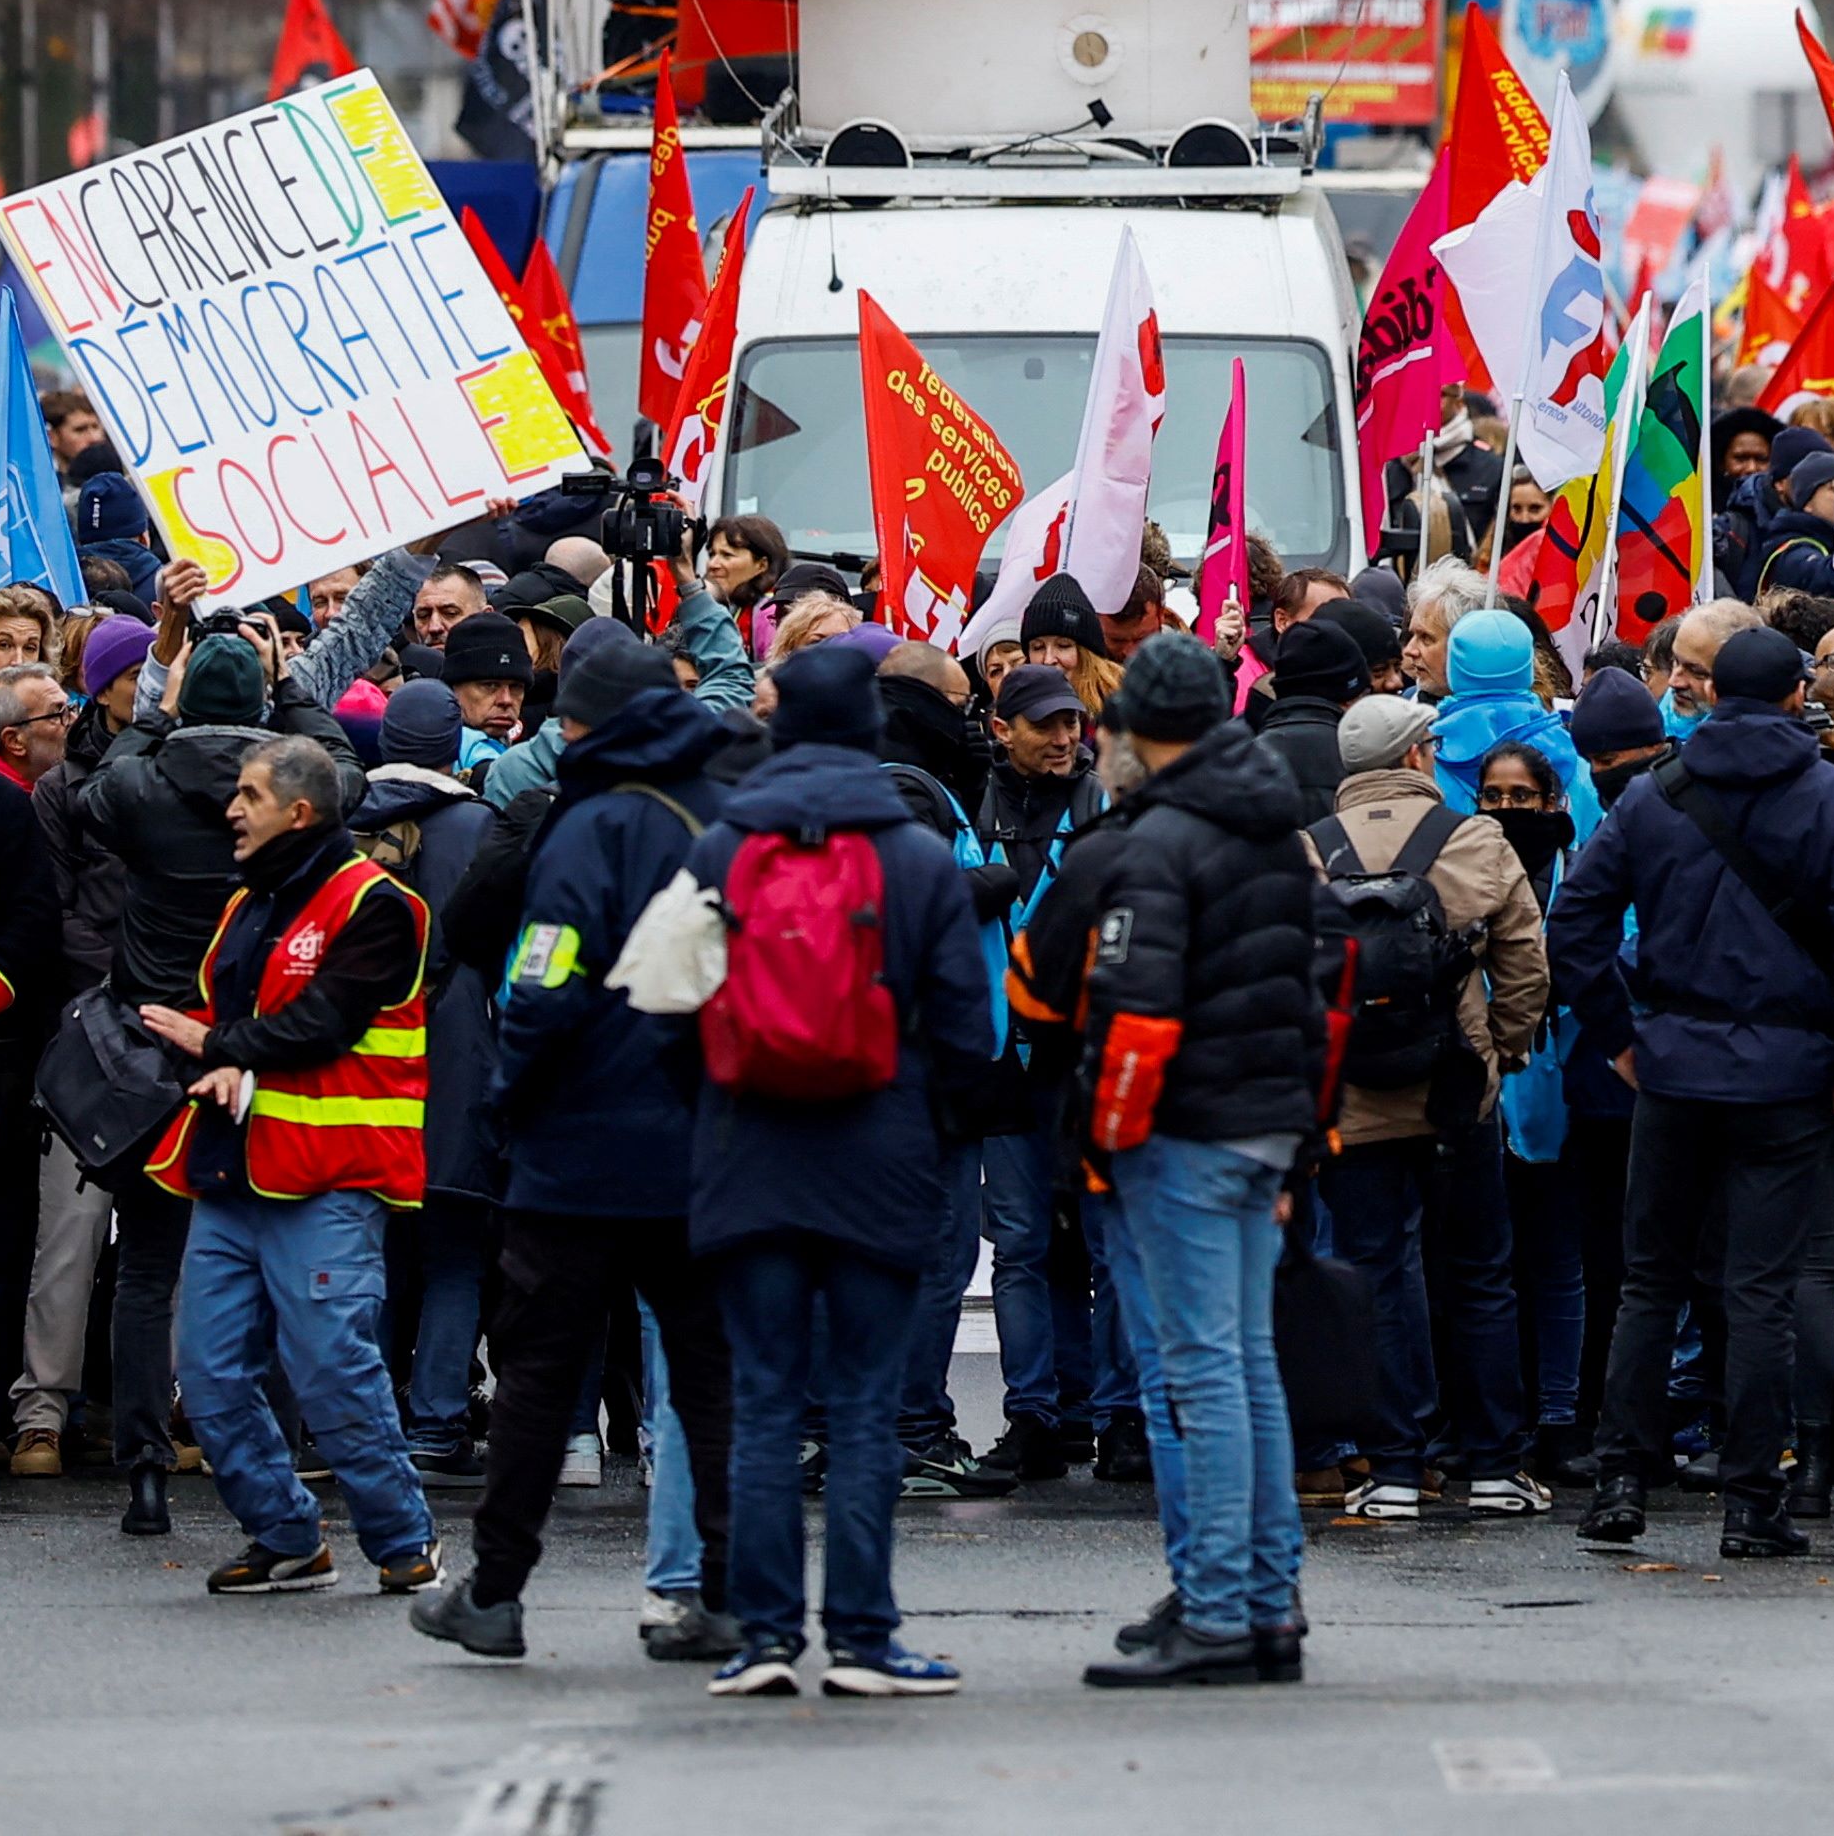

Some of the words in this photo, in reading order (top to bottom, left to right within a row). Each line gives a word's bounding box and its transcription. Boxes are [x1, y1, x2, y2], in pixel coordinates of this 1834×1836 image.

[3, 190, 121, 333] EN
[79, 115, 340, 309] CARENCE
[274, 84, 421, 247] DE
[68, 222, 512, 467] DÉMOCRATIE
[886, 368, 928, 418] des
[929, 412, 1012, 511] services
[924, 448, 992, 535] publics
